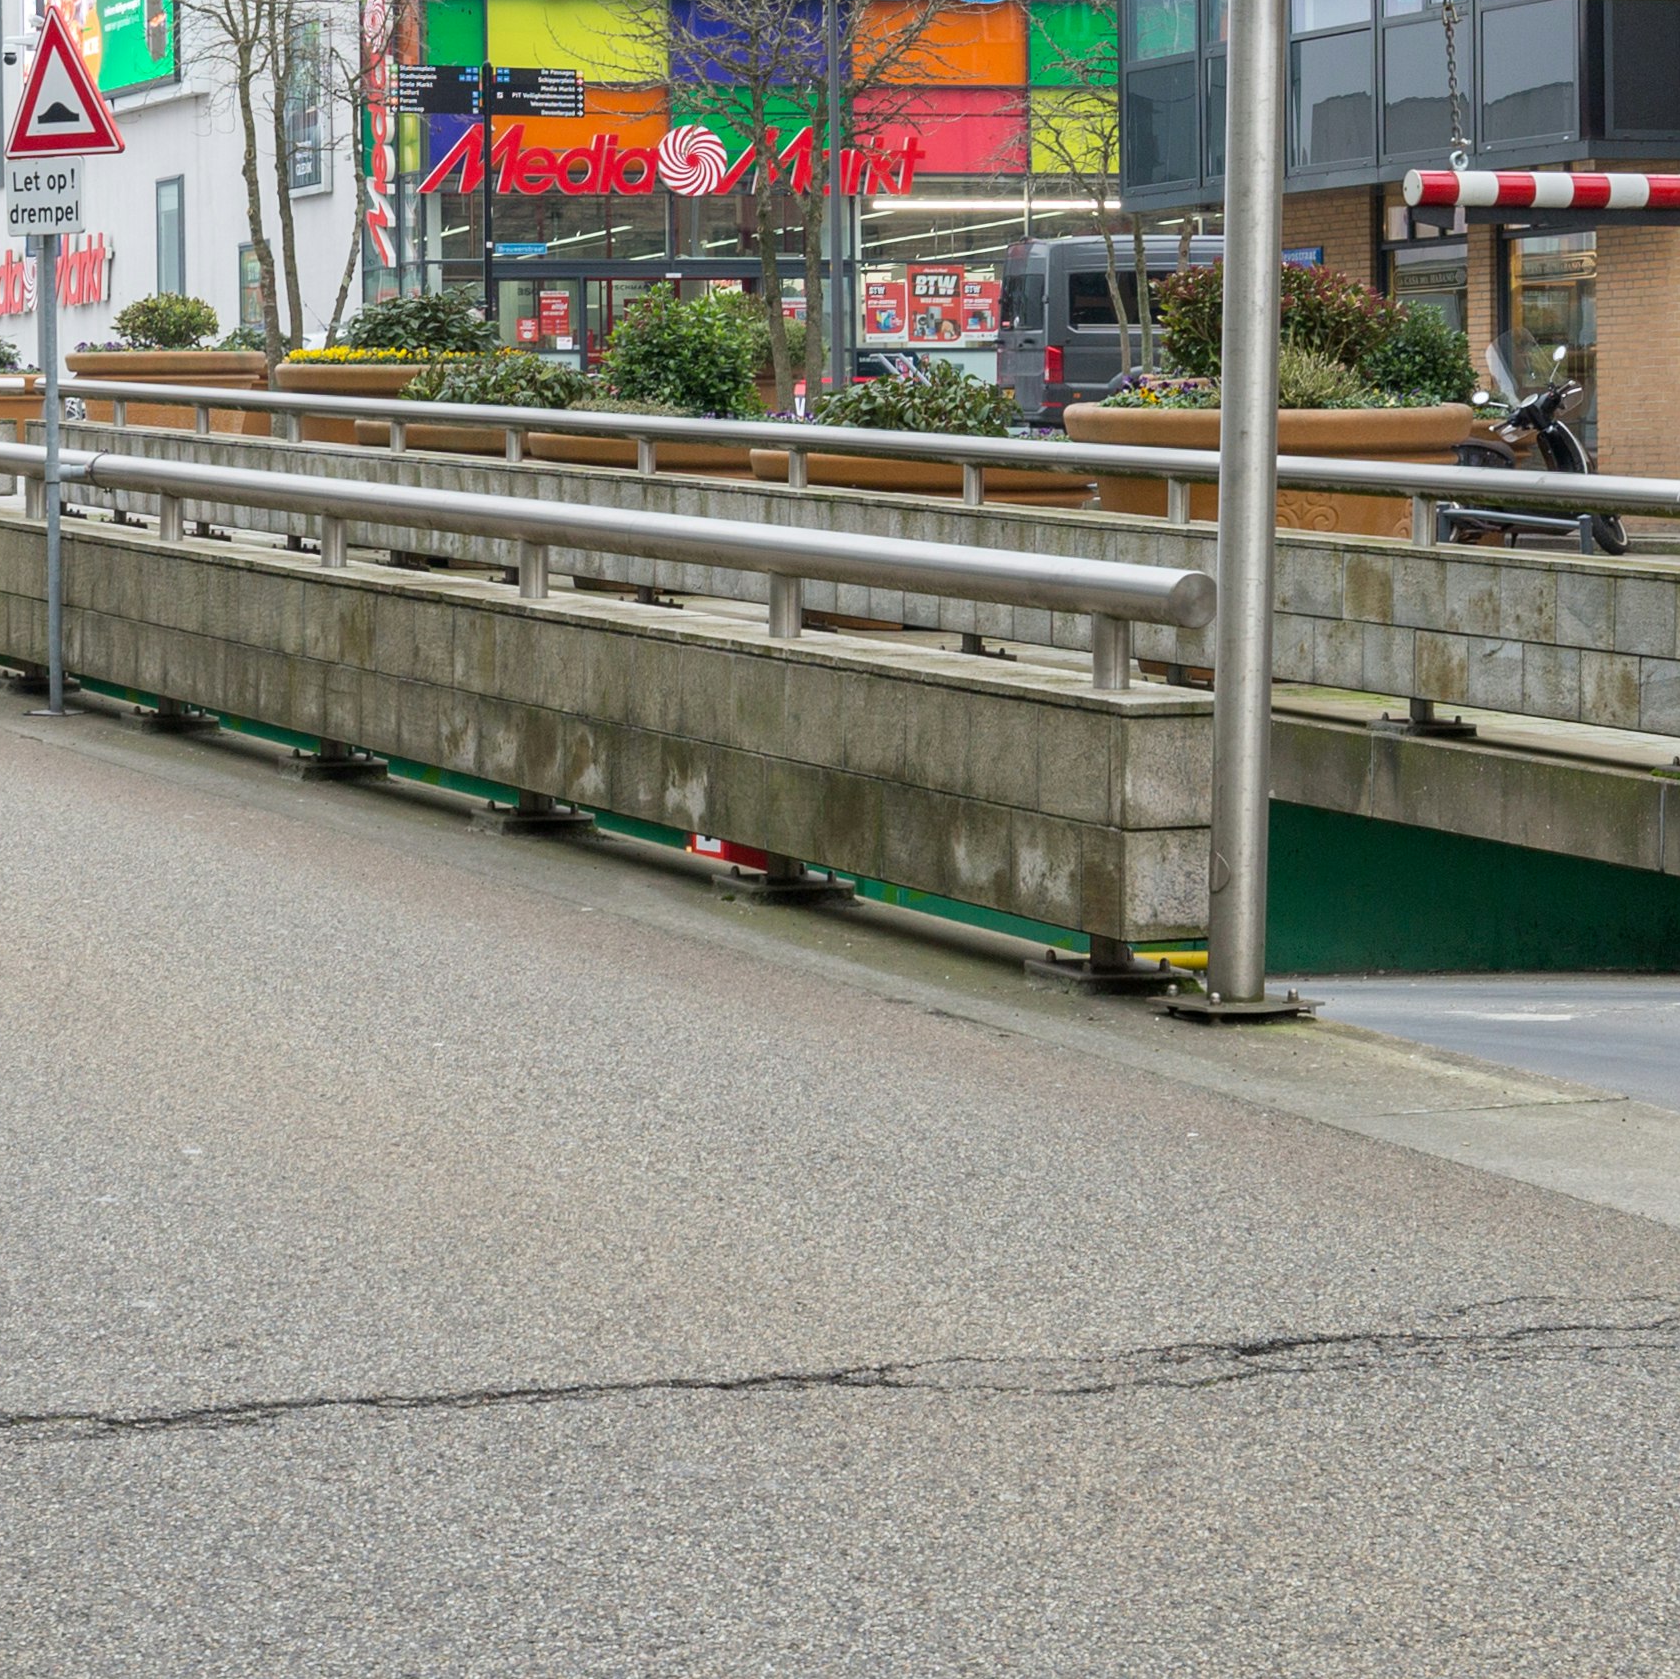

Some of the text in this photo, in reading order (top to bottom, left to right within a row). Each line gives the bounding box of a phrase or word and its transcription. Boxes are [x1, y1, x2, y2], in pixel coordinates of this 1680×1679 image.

[416, 123, 659, 195] Media
[12, 167, 75, 194] Let op!
[9, 199, 79, 226] drempel
[915, 275, 957, 295] BTW
